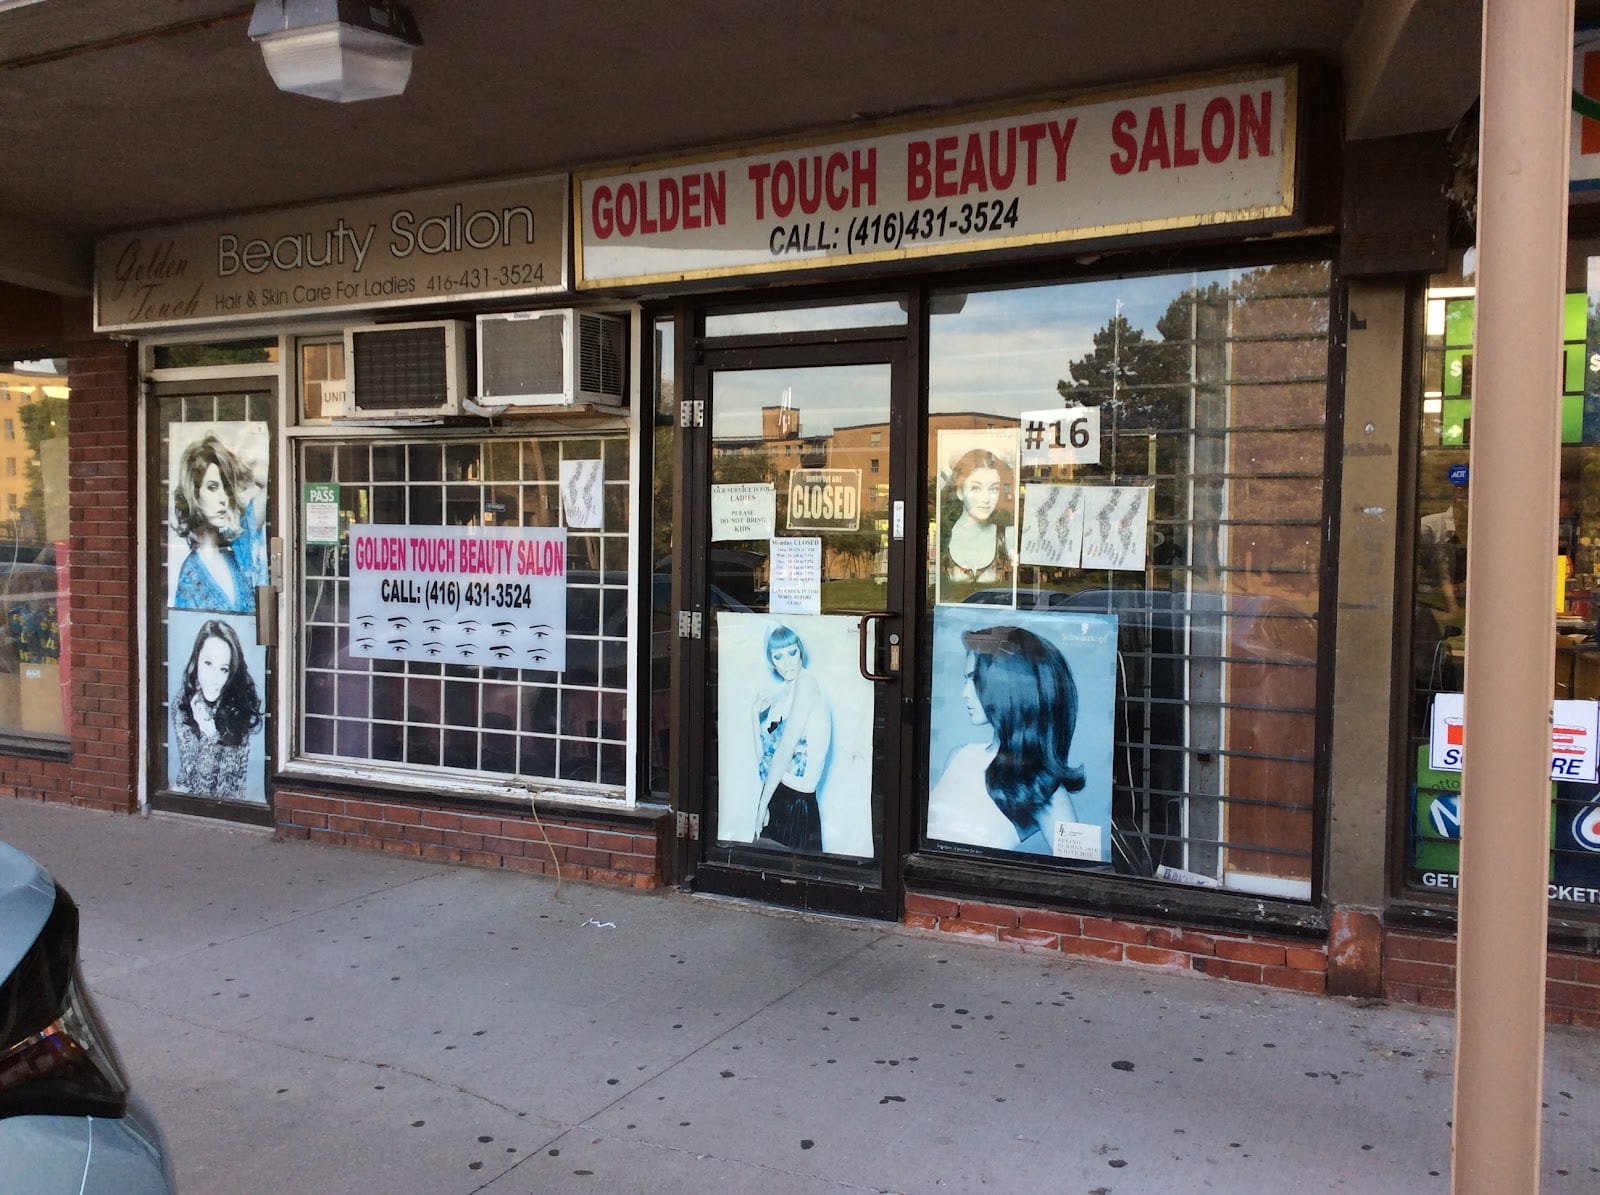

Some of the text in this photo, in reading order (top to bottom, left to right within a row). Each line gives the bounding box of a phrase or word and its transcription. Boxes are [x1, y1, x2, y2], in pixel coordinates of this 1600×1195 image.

[591, 91, 1272, 240] GOLDEN TOUCH BEAUTY SALON
[217, 202, 535, 277] Beauty Salon
[769, 197, 1020, 256] CALL: (416)431-3524
[112, 239, 188, 301] Golden
[215, 263, 544, 312] Hair & Skin Care For Ladies 416-431-3524
[129, 281, 204, 322] Touch
[1024, 417, 1089, 450] #16
[1451, 470, 1467, 479] ADT
[310, 490, 335, 503] PASS
[792, 484, 856, 520] CLOSED
[355, 536, 564, 577] GOLDEN TOUCH BEAUTY SALON
[381, 579, 532, 612] CALL: (416) 431-3524
[1422, 872, 1459, 889] GET
[1548, 884, 1600, 905] CKET
